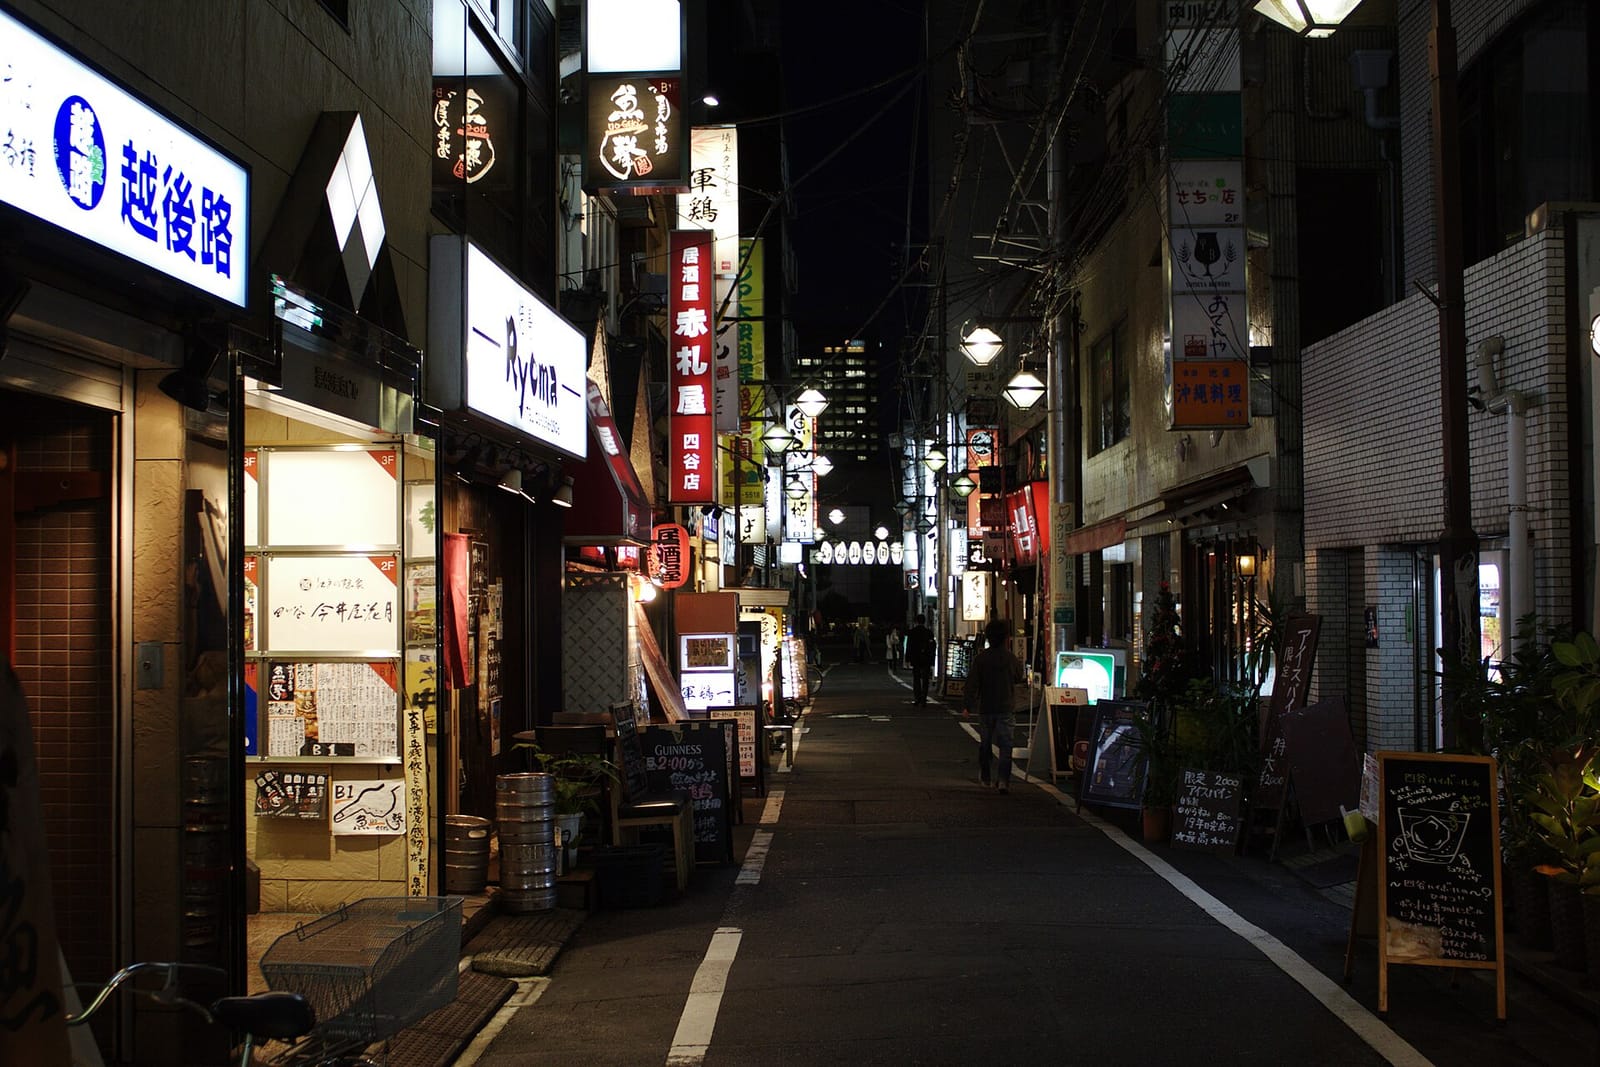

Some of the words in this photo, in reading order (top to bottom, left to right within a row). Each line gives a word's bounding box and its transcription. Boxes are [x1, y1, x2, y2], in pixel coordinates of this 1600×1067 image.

[688, 167, 719, 222] 軍鶏
[120, 139, 233, 279] 越後路
[1225, 213, 1239, 222] 2F
[682, 246, 700, 301] 居酒屋
[1208, 295, 1229, 358] おでんや
[675, 308, 709, 415] 赤札屋
[1176, 383, 1242, 404] 沖縄料理
[381, 456, 394, 465] 3F
[683, 433, 699, 490] 四谷店
[381, 561, 394, 571] 2F
[1284, 629, 1312, 715] アイスバイ
[1060, 695, 1077, 704] Duvel
[312, 744, 338, 756] B1
[655, 744, 702, 756] GUINNESS
[1263, 738, 1287, 773] 特大
[1184, 771, 1207, 786] 限定
[335, 785, 353, 799] B1
[1186, 785, 1233, 800] アイスバイン
